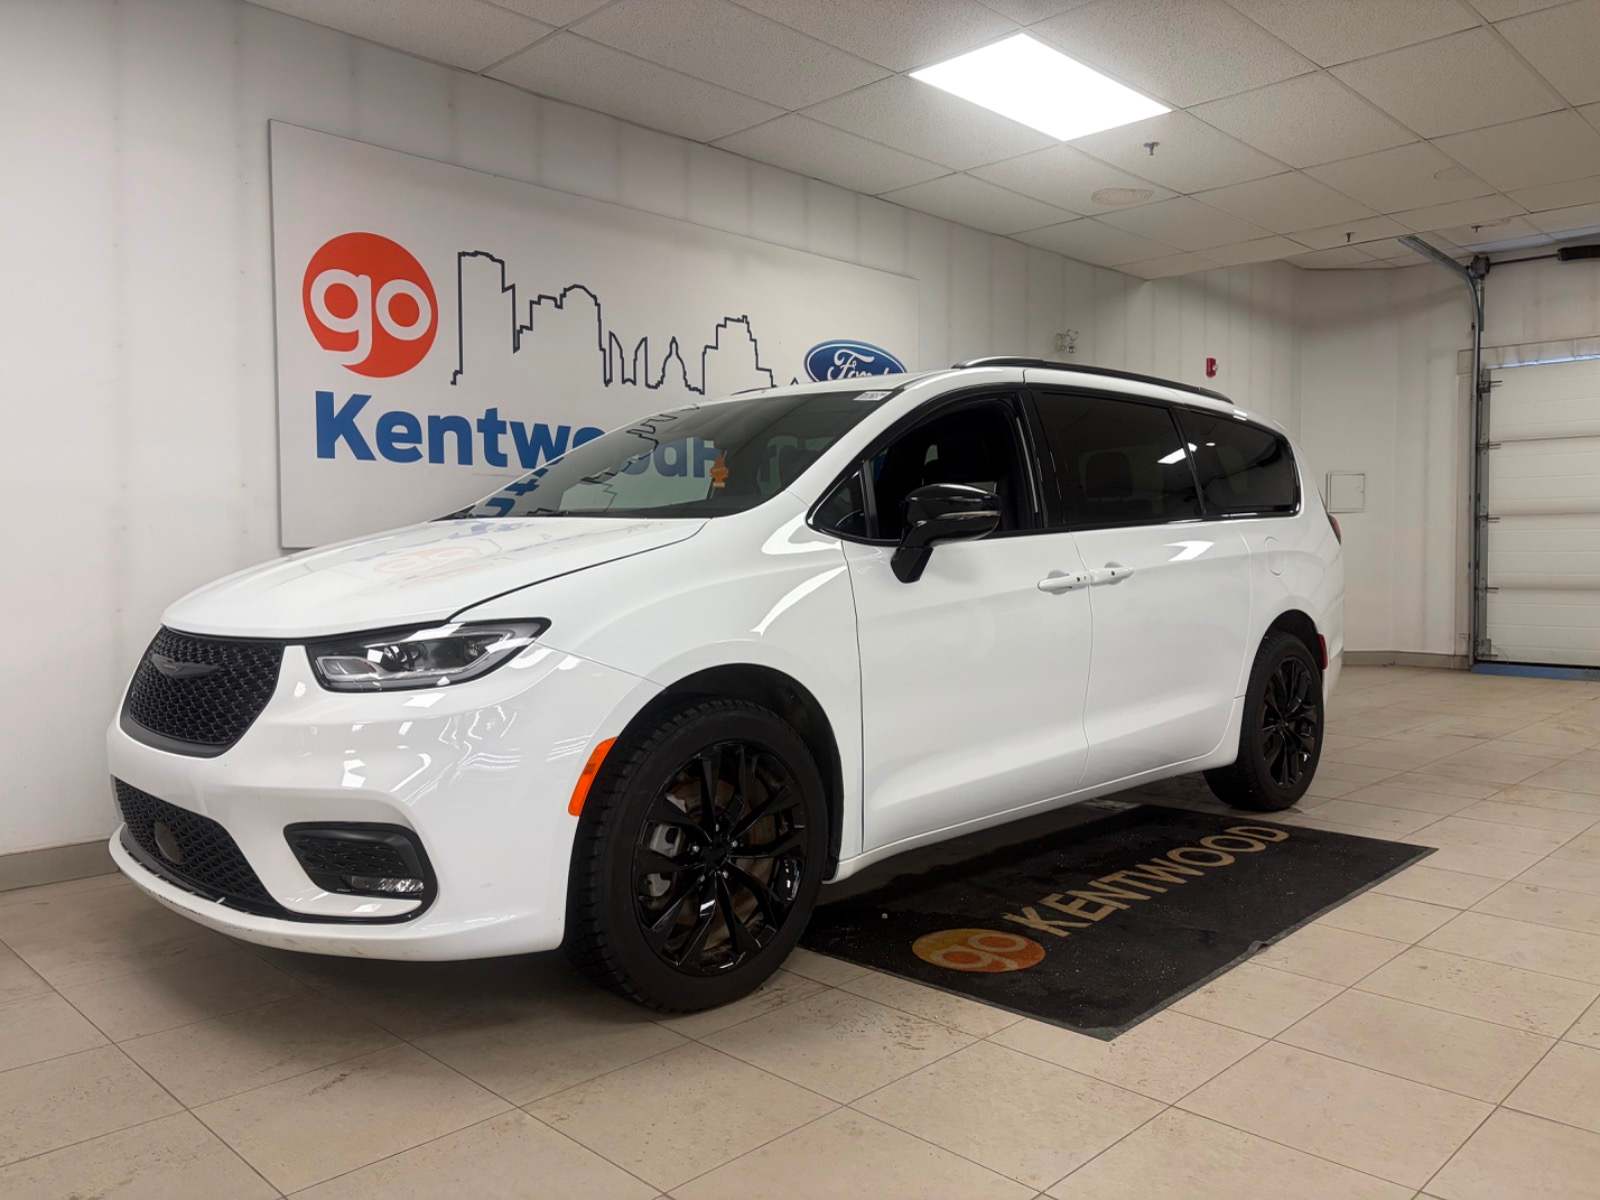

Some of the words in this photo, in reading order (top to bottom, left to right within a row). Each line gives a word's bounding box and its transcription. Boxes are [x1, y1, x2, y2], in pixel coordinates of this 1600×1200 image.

[310, 268, 433, 366] go
[930, 932, 1027, 971] go
[1002, 826, 1290, 937] KENTWOOD
